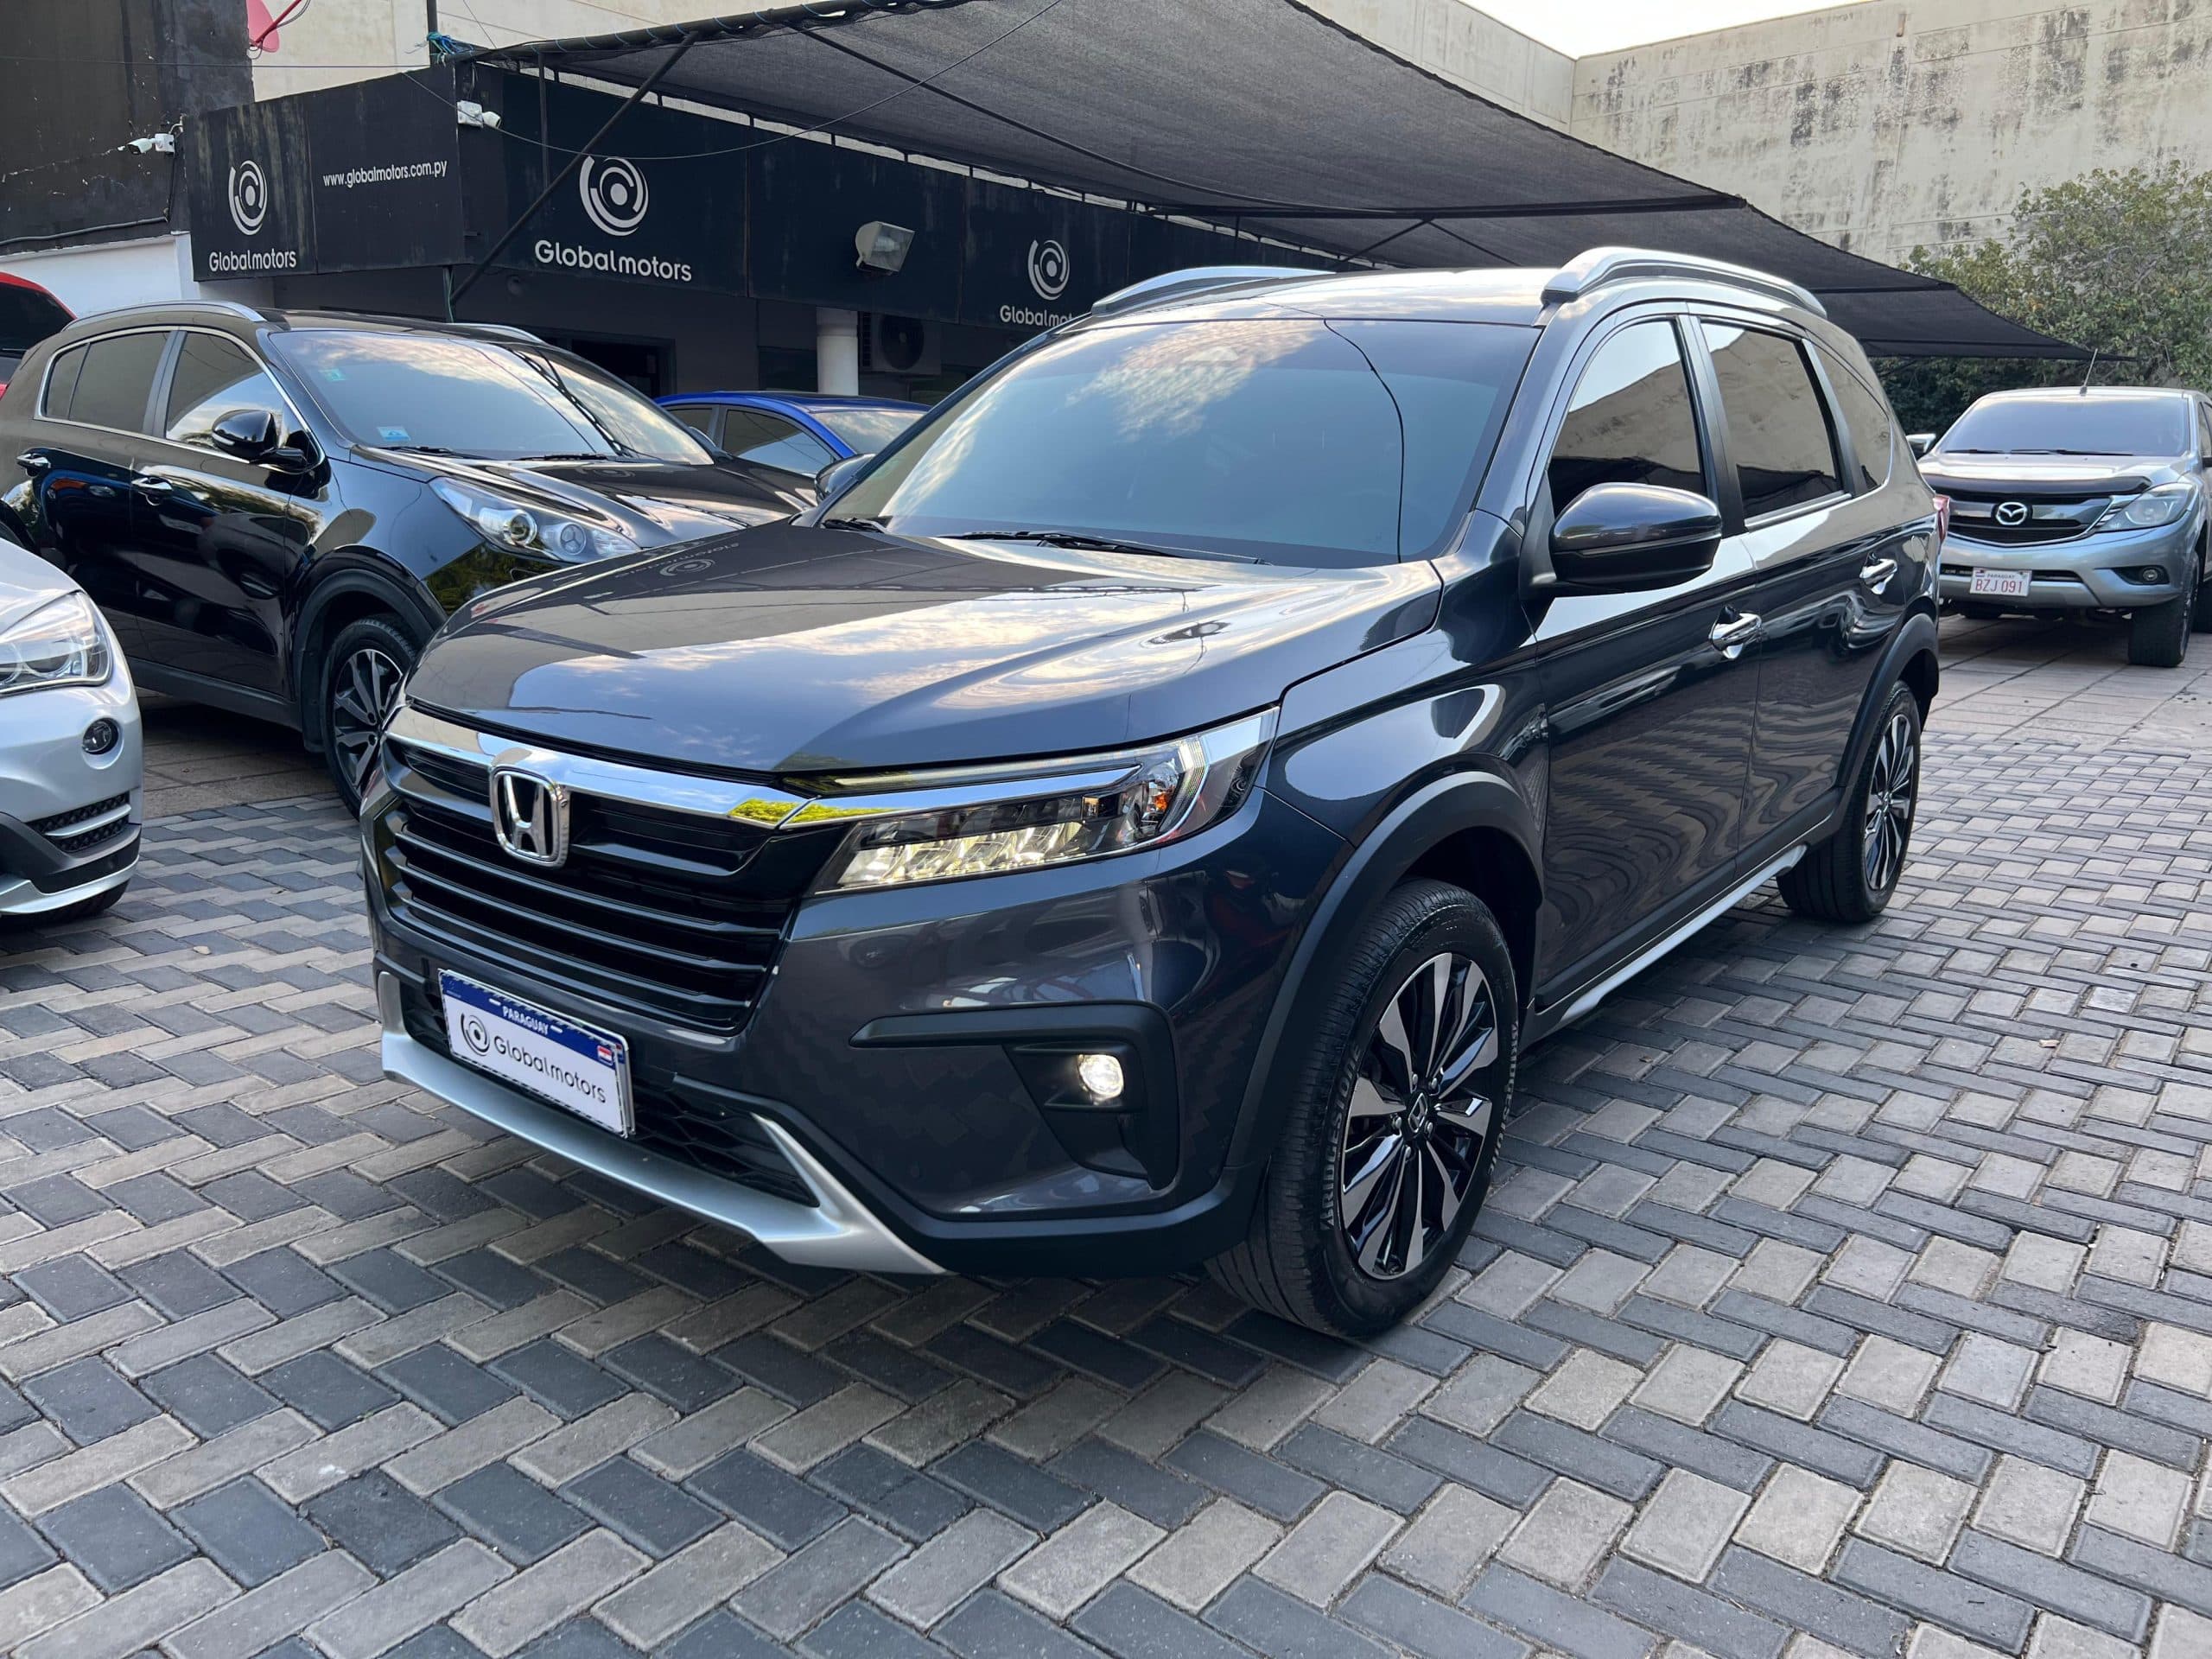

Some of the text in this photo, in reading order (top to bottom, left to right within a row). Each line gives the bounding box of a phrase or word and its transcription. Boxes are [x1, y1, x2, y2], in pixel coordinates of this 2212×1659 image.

[323, 161, 448, 188] www.globalmotors.com.py
[208, 248, 297, 272] Globalmotors
[535, 239, 692, 282] Globalmotors
[1975, 578, 2023, 594] BZJ 091
[502, 1005, 550, 1036] PARAGUAY
[493, 1035, 607, 1103] Globalmotors
